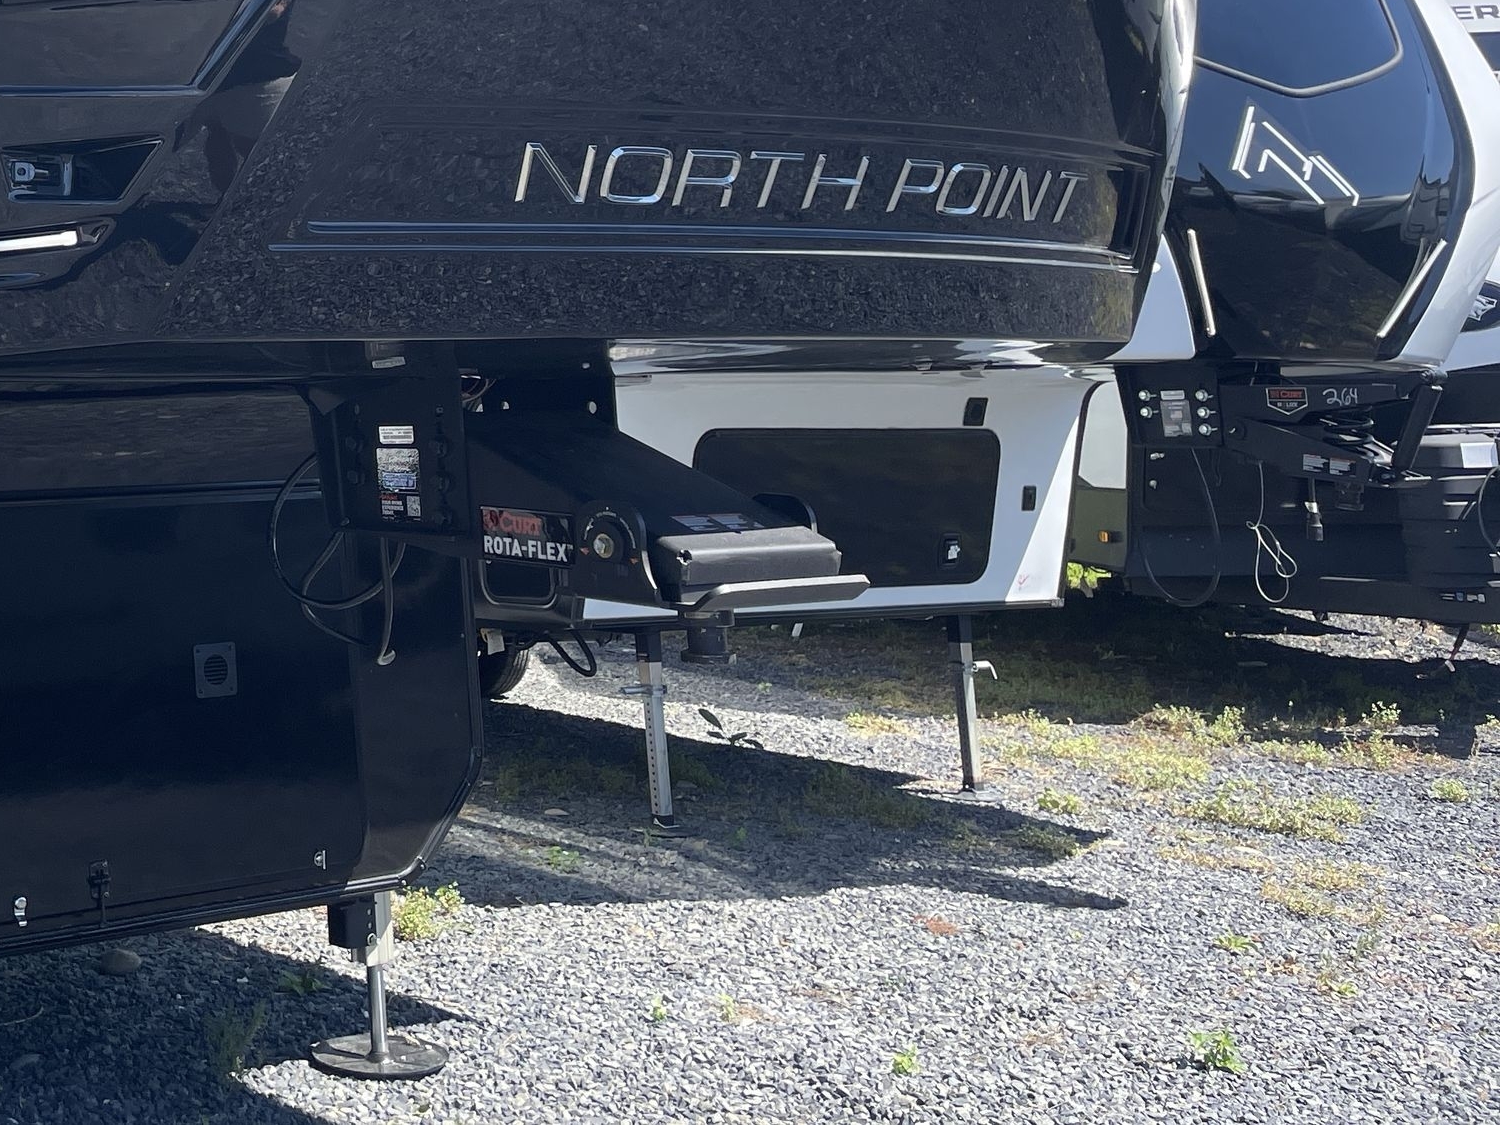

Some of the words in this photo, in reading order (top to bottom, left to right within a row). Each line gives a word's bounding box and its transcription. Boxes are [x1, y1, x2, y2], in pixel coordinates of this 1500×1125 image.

[513, 142, 870, 211] NORTH
[885, 158, 1089, 224] POINT
[1322, 387, 1359, 407] 264
